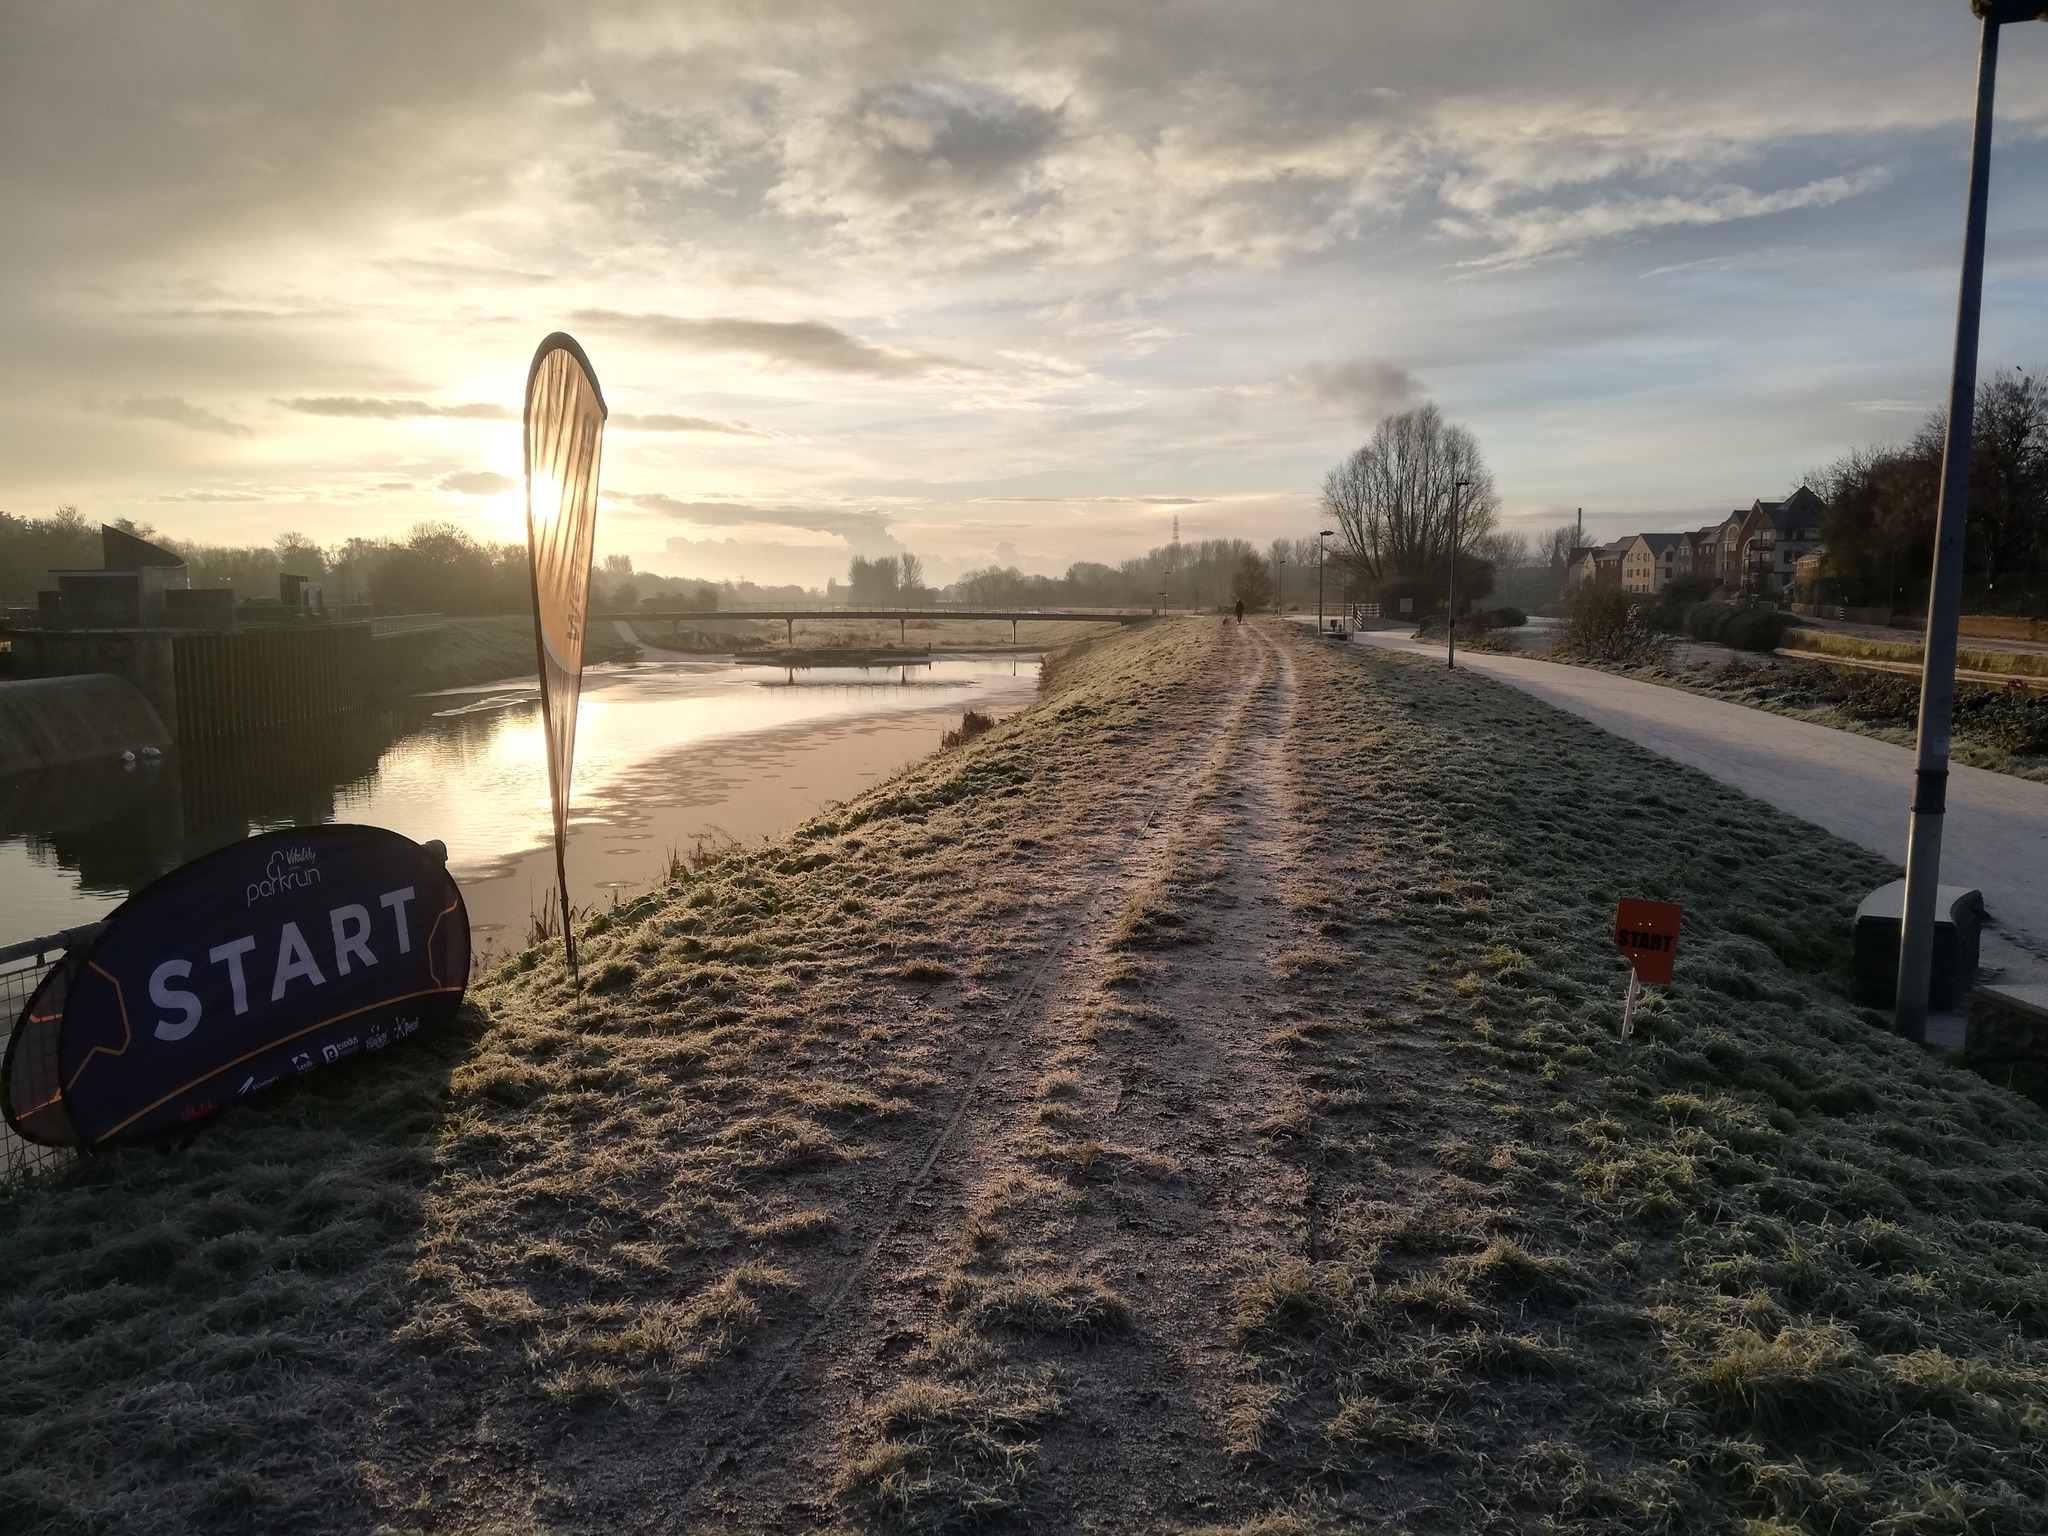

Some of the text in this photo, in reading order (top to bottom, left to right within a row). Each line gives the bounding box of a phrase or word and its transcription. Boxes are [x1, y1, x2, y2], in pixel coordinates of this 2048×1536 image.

[286, 846, 316, 865] Vitality
[246, 865, 321, 907] parkrun
[1618, 929, 1674, 952] START
[148, 886, 417, 1042] START
[337, 1035, 359, 1050] exodus
[297, 1060, 314, 1071] Leeds
